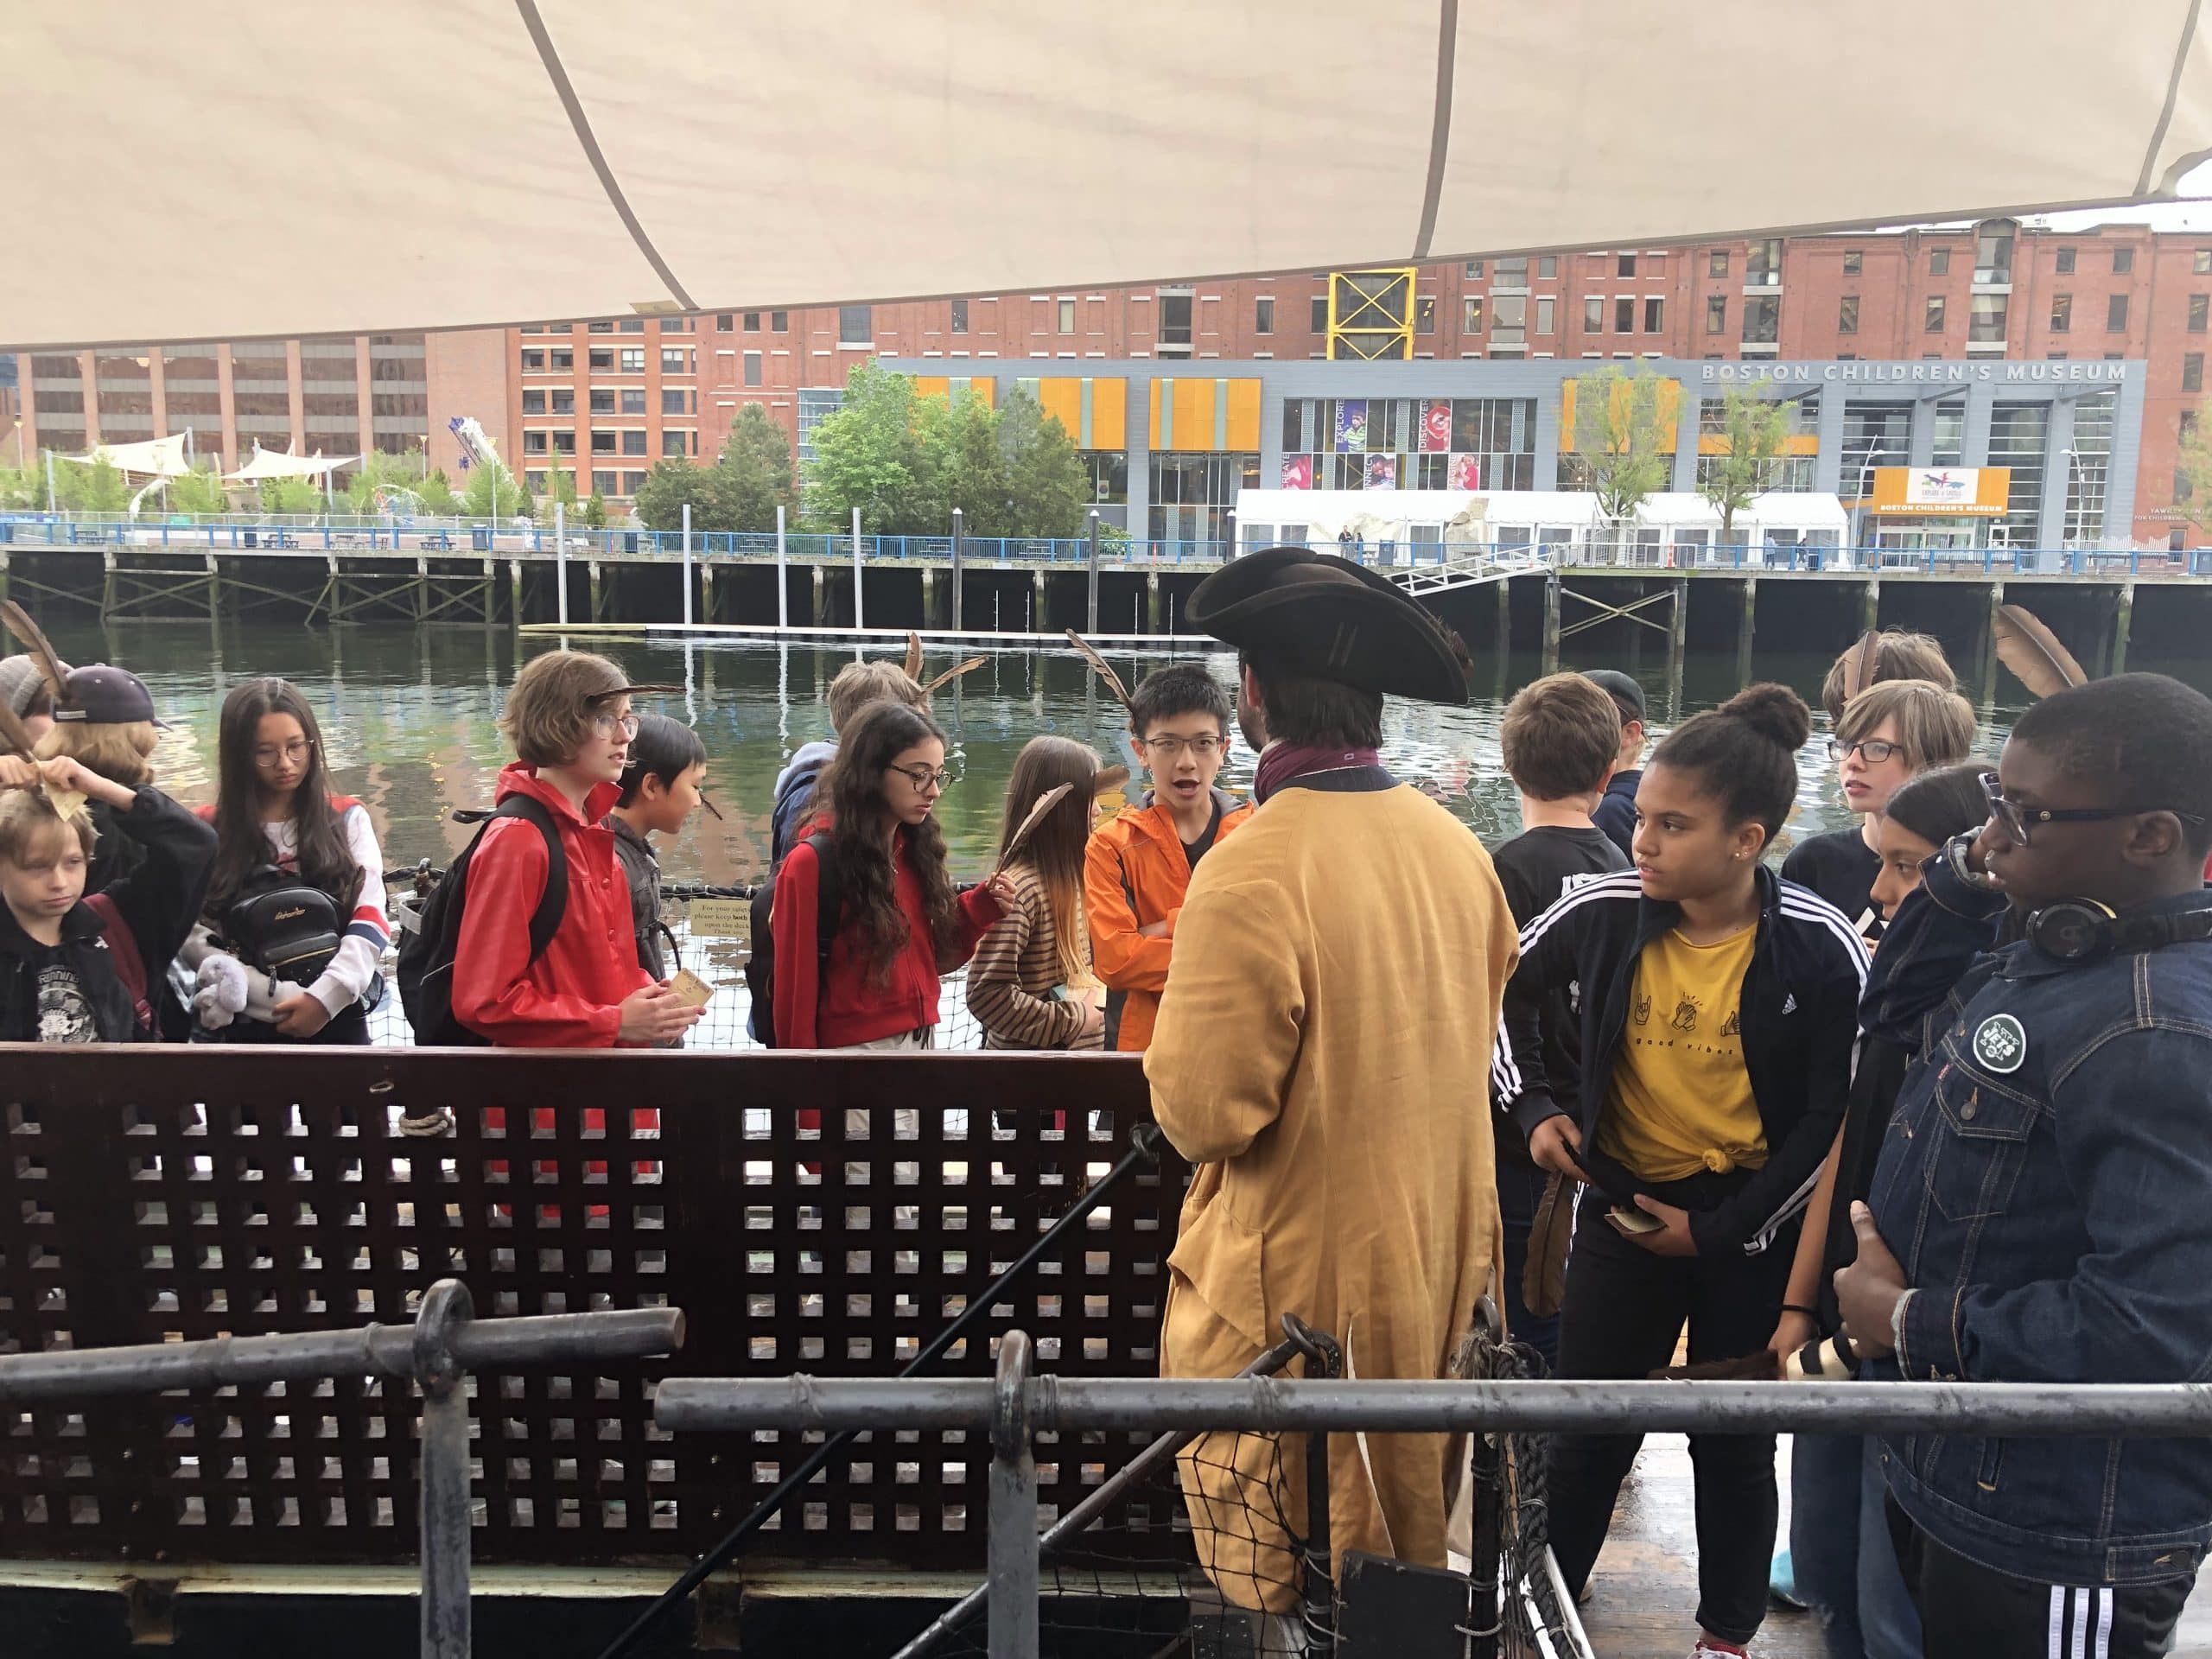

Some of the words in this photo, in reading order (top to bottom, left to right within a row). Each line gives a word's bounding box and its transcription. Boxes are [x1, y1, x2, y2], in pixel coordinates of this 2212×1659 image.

[1701, 364, 1810, 381] BOSTON
[1823, 364, 1992, 381] CHILDREN'S
[2005, 364, 2127, 381] MUSEUM
[1335, 398, 1345, 443] EXPLORE
[1420, 398, 1430, 449] DISCOVER
[1687, 1042, 1734, 1055] vibes
[1983, 1027, 2016, 1057] JETS
